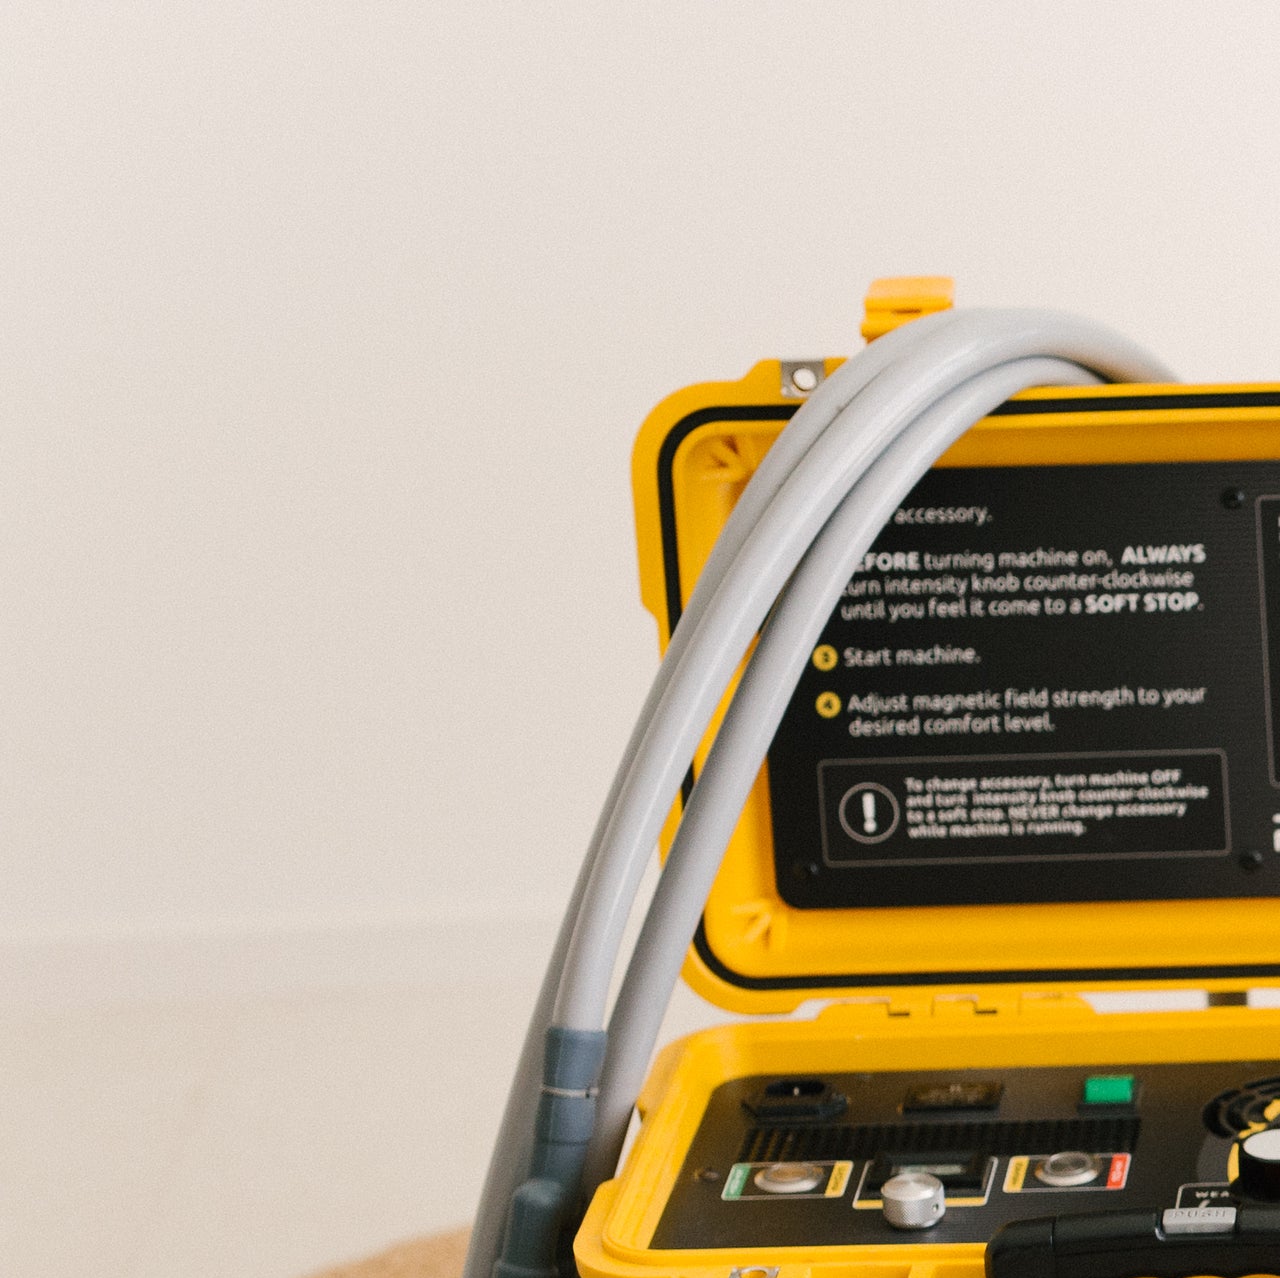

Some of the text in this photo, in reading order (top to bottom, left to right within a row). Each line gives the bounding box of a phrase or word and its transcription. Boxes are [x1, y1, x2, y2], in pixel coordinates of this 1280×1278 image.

[923, 552, 994, 572] turning
[998, 547, 1078, 567] machine
[1081, 549, 1112, 566] on,
[1120, 543, 1206, 564] ALWAYS
[843, 646, 891, 667] Start
[895, 644, 980, 665] machine.
[847, 693, 908, 715] Adjust
[912, 691, 1000, 714] magnetic
[1004, 687, 1049, 708] field
[1051, 685, 1135, 710] strength
[1137, 686, 1160, 705] to
[1161, 686, 1206, 708] your
[848, 711, 1054, 736] desired comfort level.
